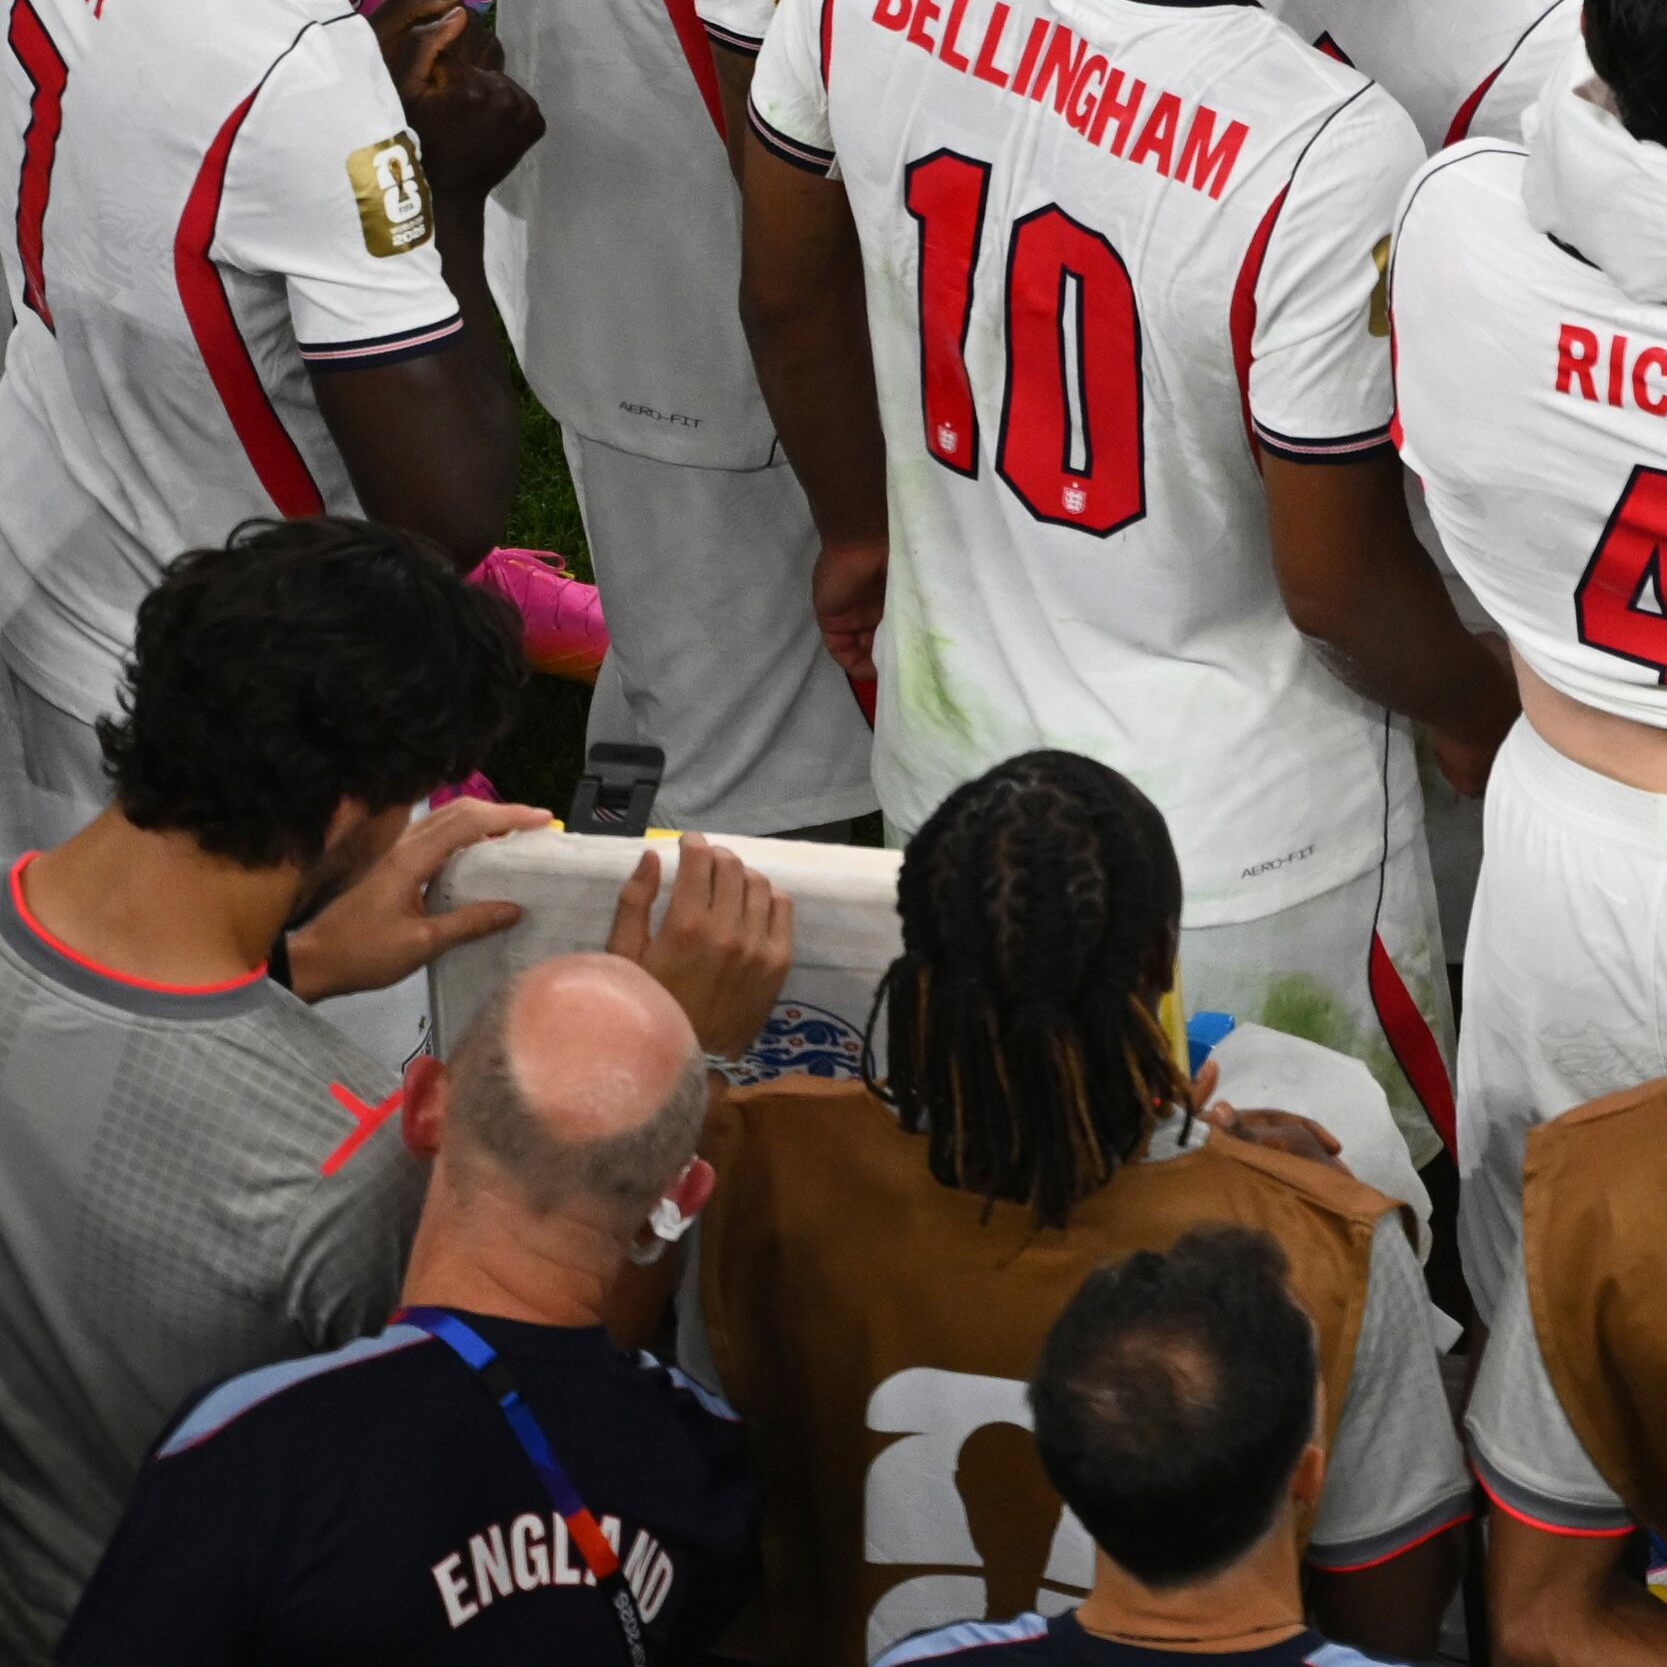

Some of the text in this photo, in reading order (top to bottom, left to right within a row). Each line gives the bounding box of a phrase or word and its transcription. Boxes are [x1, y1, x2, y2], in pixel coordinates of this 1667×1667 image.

[902, 146, 1148, 540] 10
[619, 400, 703, 429] AERO-FIT
[1241, 843, 1317, 880] AERO-FIT
